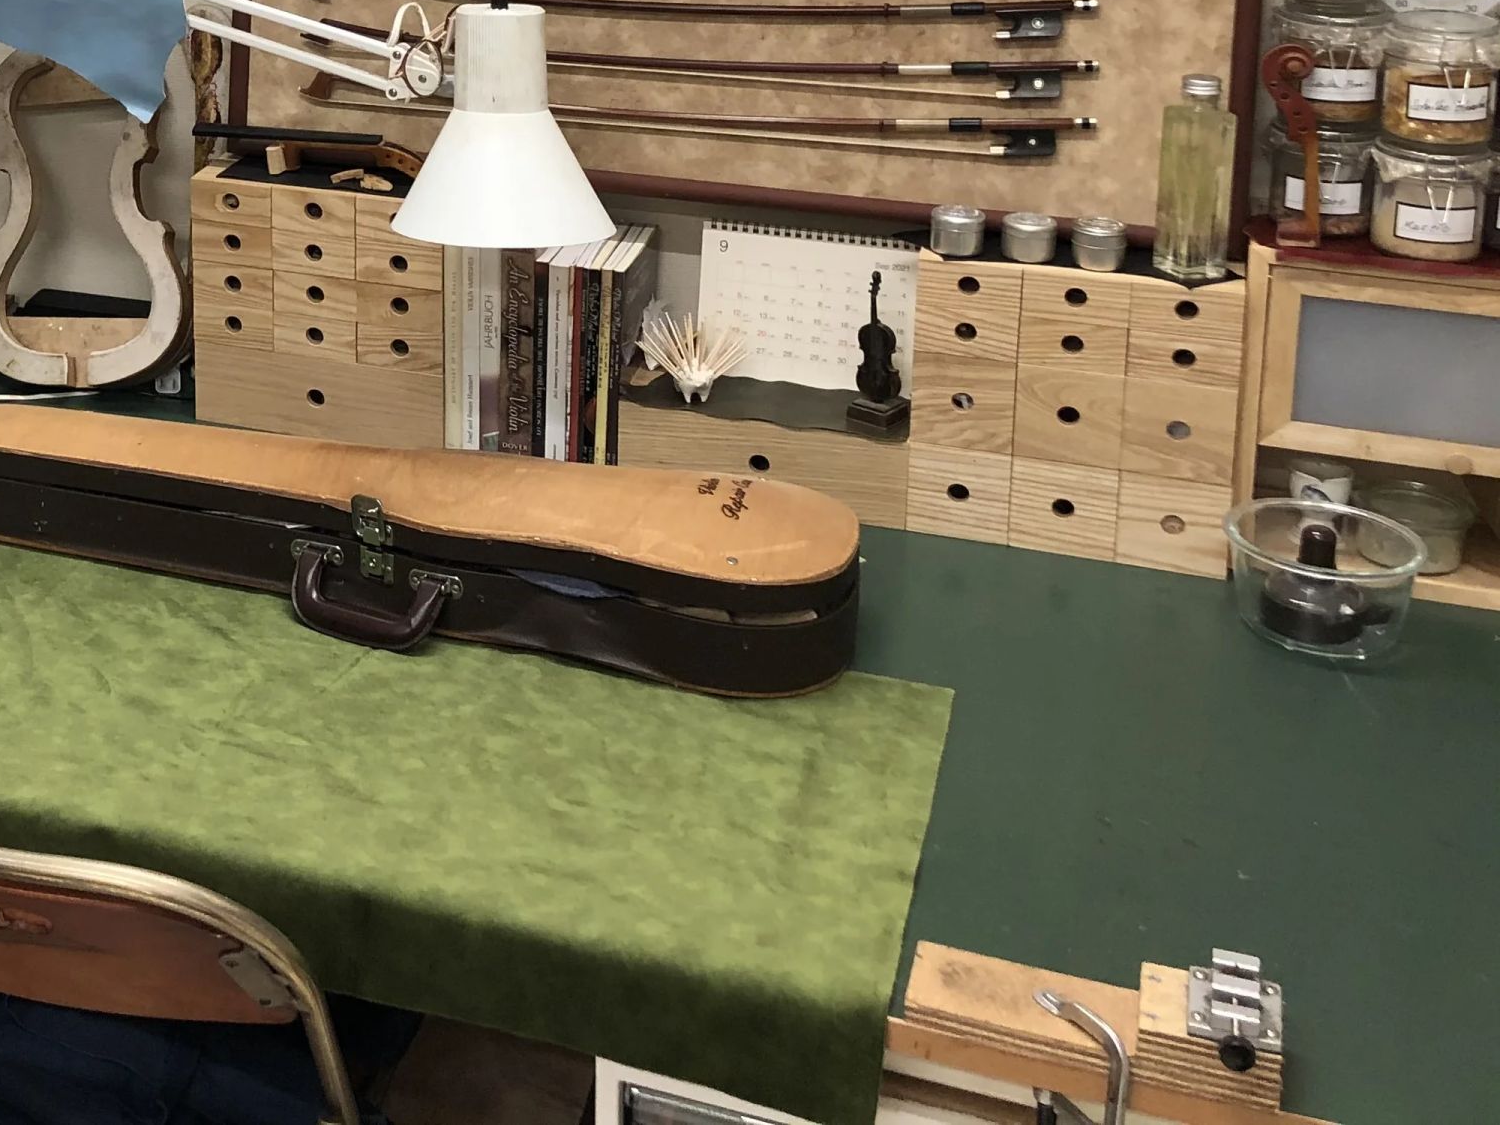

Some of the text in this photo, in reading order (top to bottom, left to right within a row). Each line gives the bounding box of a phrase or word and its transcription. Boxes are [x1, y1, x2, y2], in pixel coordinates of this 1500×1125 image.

[719, 239, 729, 252] 9
[507, 257, 529, 285] An
[483, 294, 494, 349] JAHRBUCH
[505, 287, 531, 369] Encyclopedia
[837, 357, 847, 365] 30
[509, 395, 529, 432] Violin
[502, 441, 528, 451] DOVER
